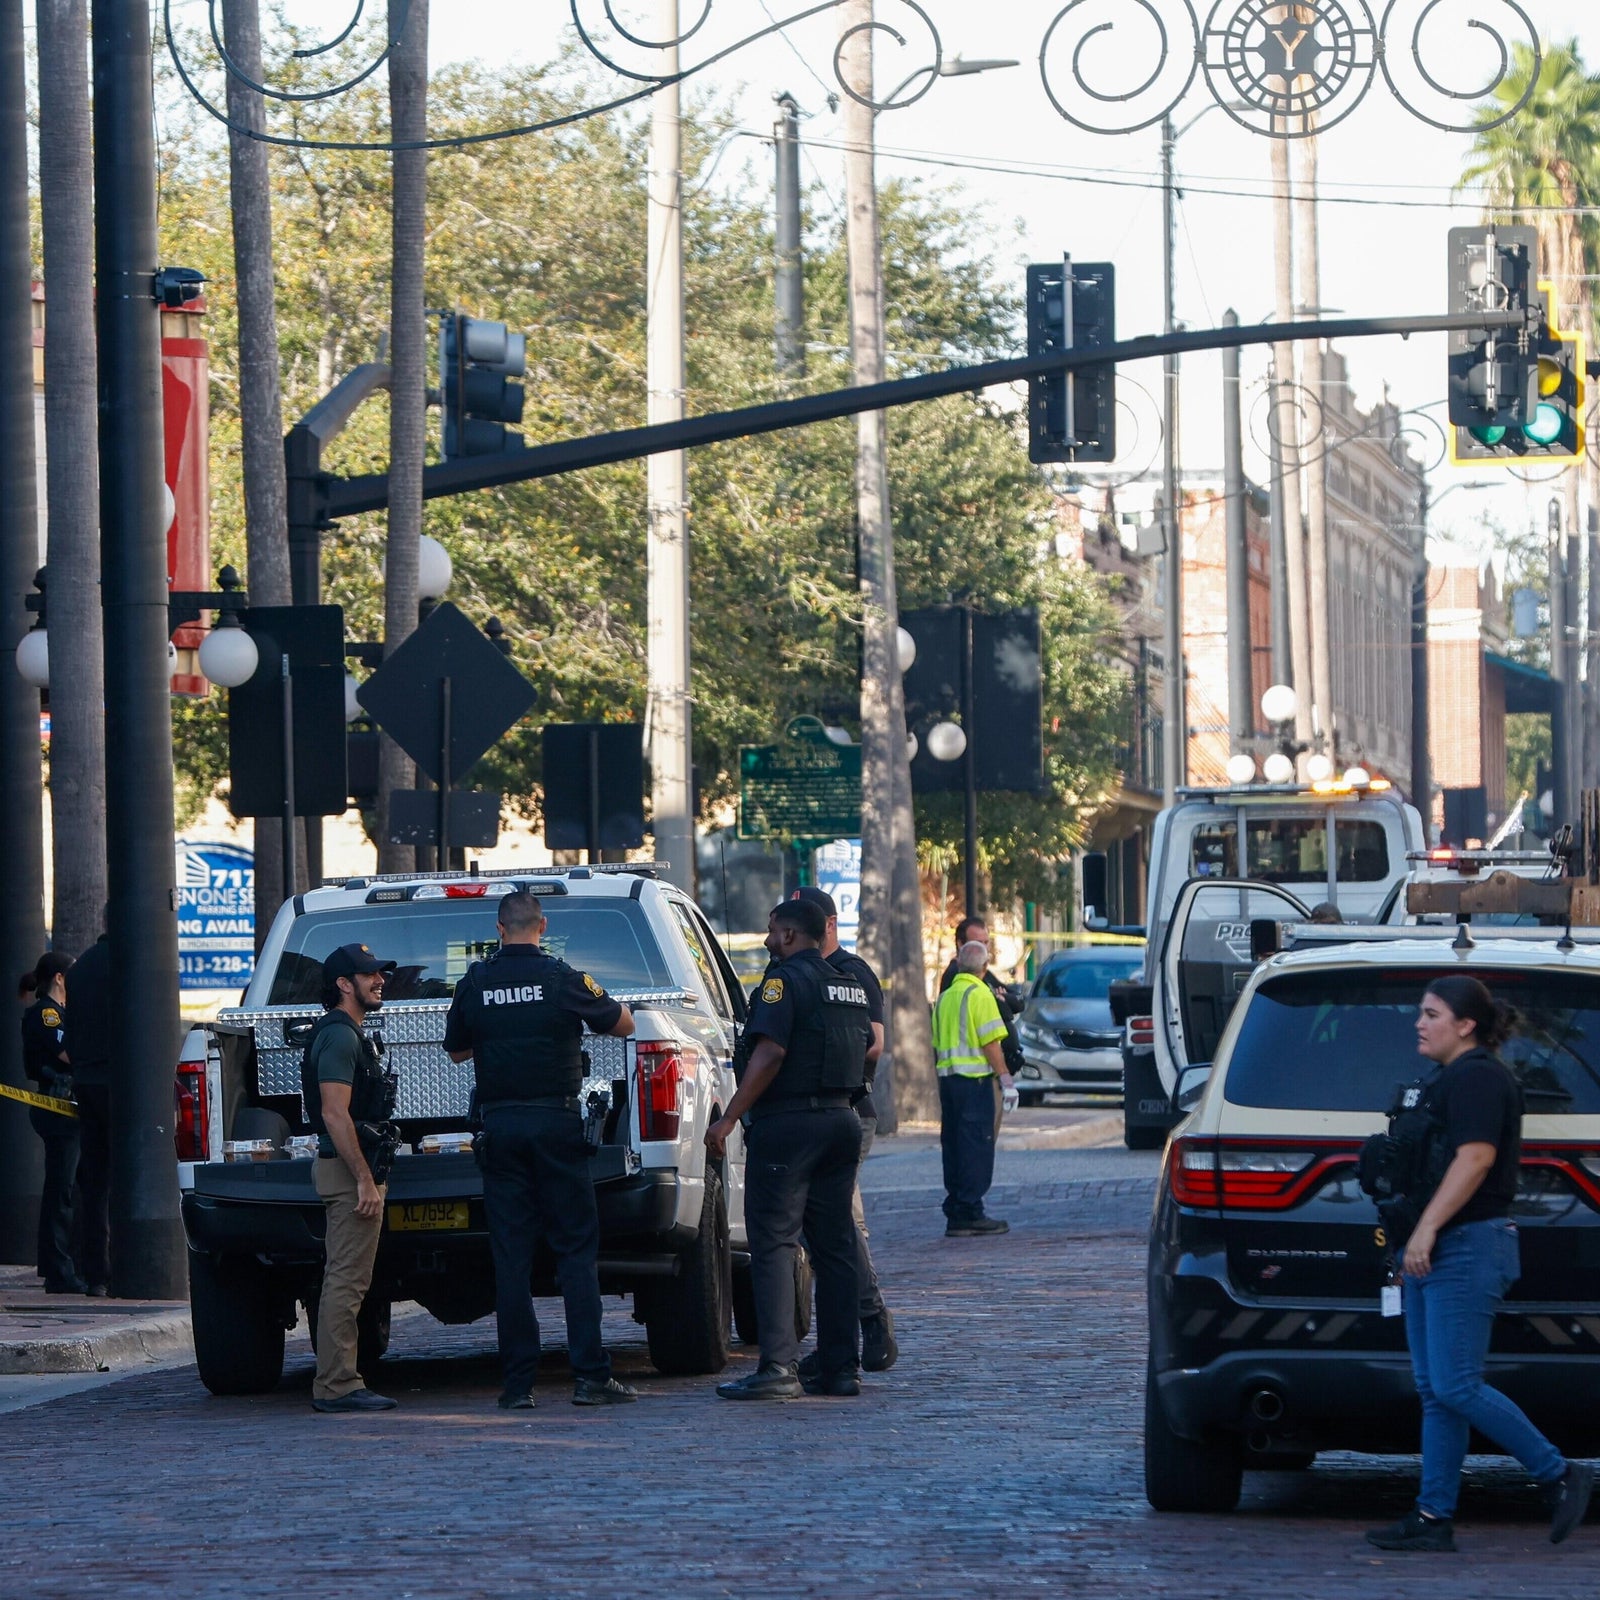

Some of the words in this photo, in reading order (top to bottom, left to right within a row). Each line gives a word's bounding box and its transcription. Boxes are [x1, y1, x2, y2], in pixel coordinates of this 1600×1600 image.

[1272, 30, 1308, 71] Y
[205, 919, 254, 934] AVAIL
[482, 985, 544, 1006] POLICE
[827, 985, 868, 1005] POLICE
